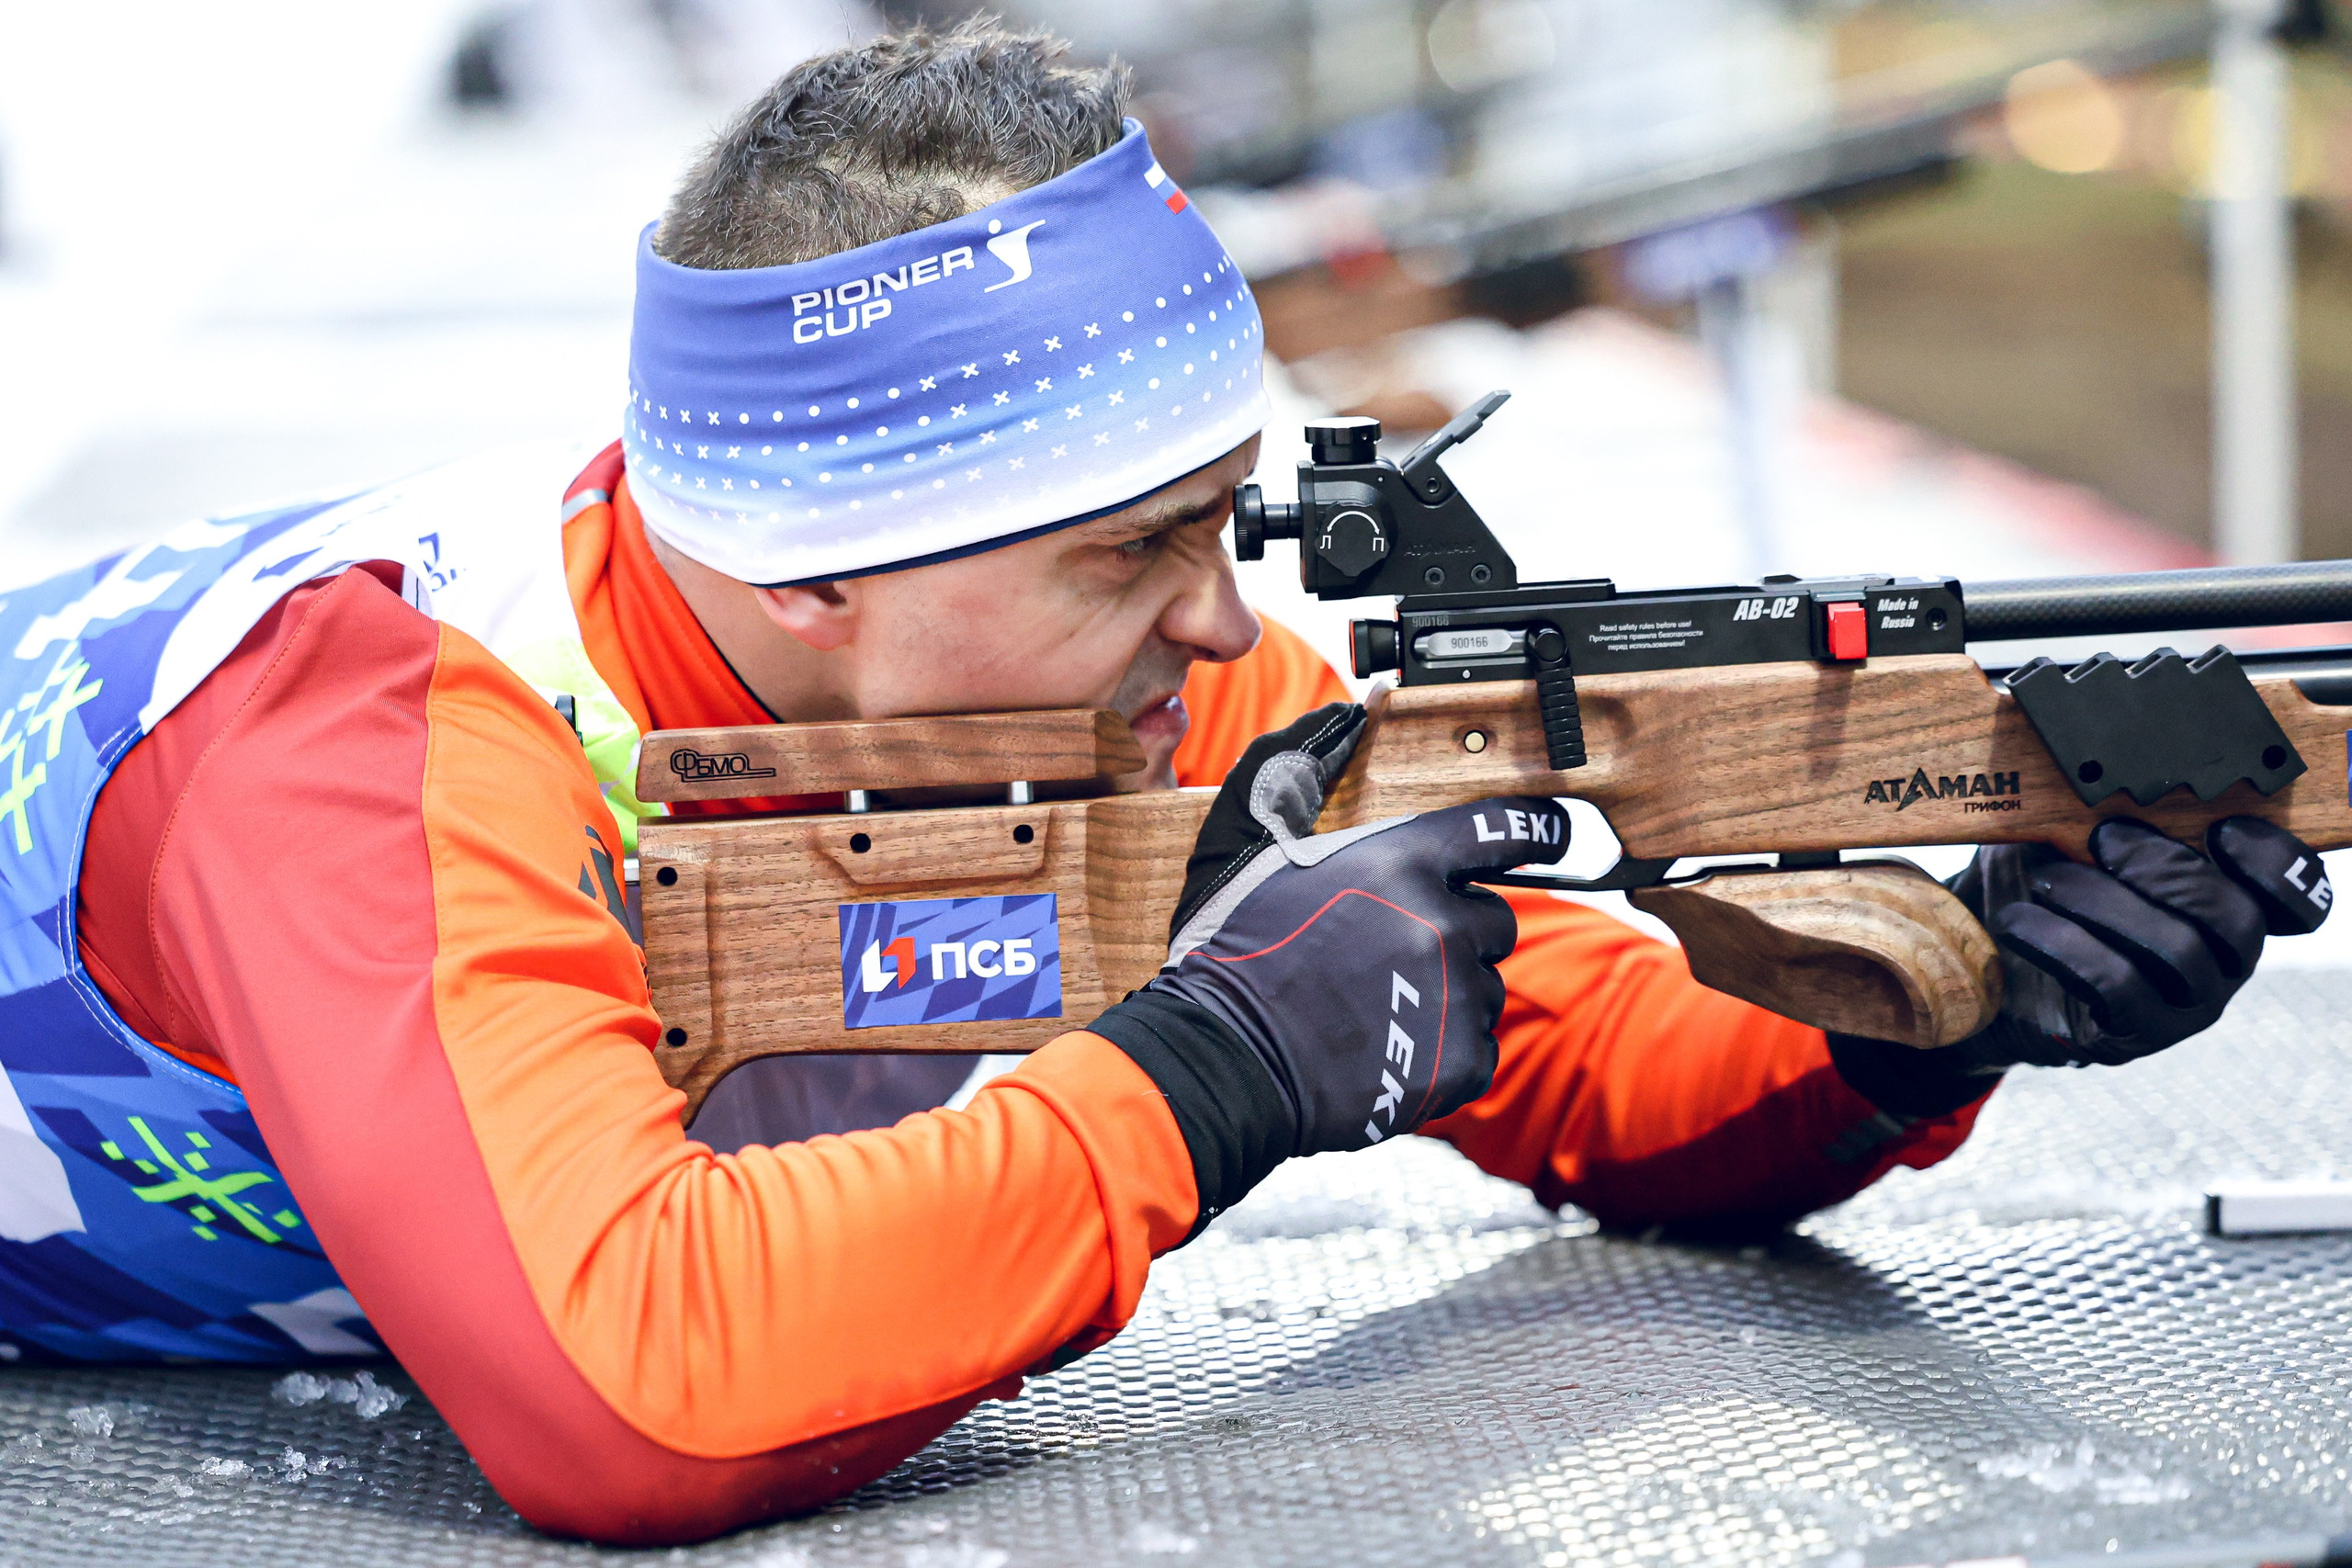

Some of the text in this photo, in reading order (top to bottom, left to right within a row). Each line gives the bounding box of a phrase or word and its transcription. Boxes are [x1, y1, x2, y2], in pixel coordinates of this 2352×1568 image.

[791, 246, 975, 317] PIONER
[793, 299, 892, 344] CUP
[1733, 597, 1799, 621] AB-02
[1877, 597, 1919, 612] Made in
[1412, 615, 1450, 627] 900166
[1619, 624, 1638, 632] safety
[1882, 615, 1916, 629] Russia
[1451, 637, 1488, 649] 900166
[1589, 634, 1628, 643] Прочитайте
[1658, 630, 1704, 639] безопасности
[1864, 767, 2020, 811] АТАМАН
[1963, 800, 2020, 813] ГРИФОН
[1472, 809, 1561, 844] LEKI
[931, 938, 1036, 980] ПСБ
[1364, 970, 1419, 1144] LEKI
